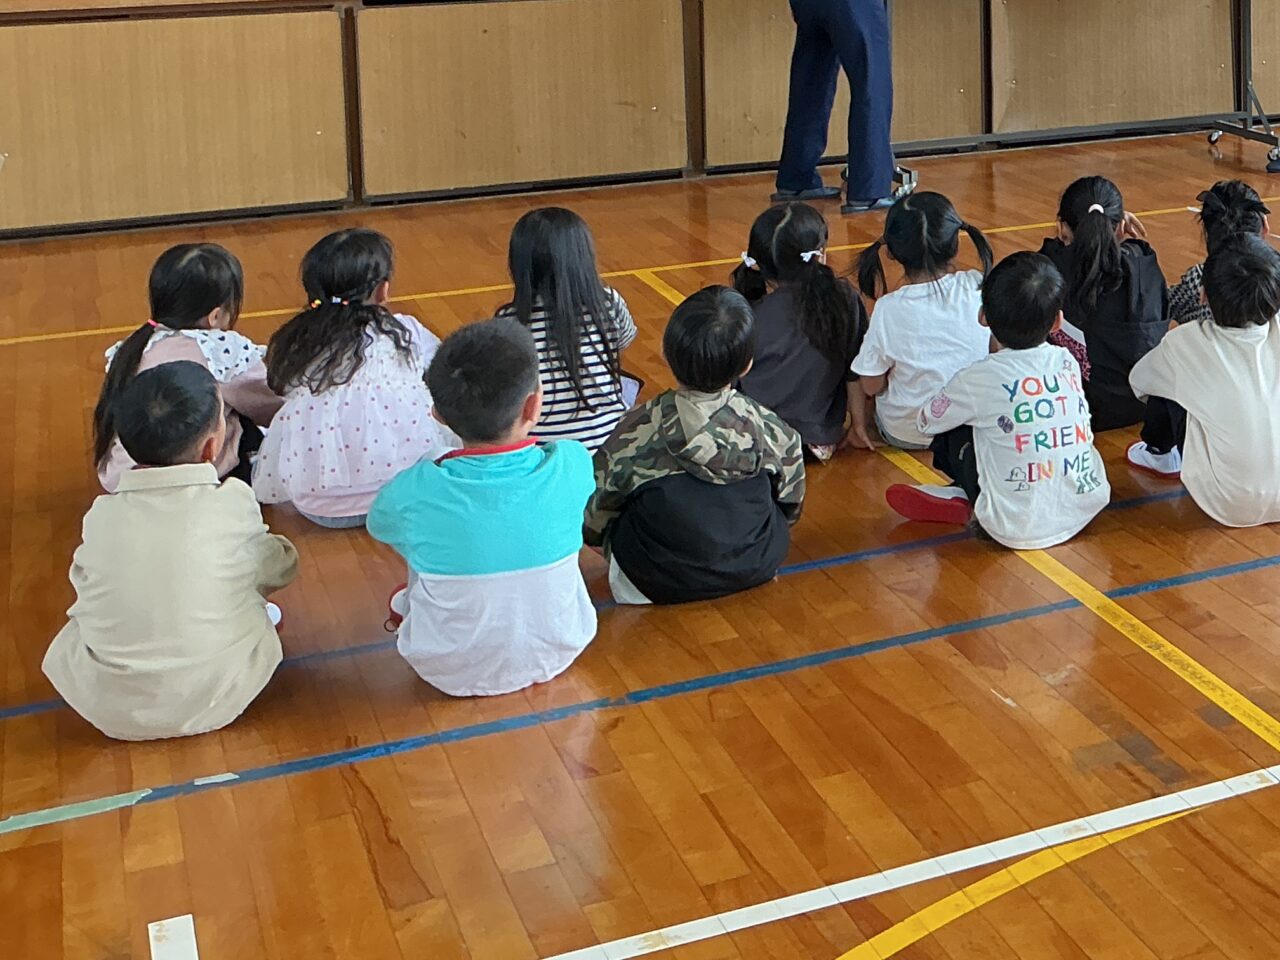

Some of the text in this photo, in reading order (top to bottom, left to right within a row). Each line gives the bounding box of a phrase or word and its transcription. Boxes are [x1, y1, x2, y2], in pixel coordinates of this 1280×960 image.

[1014, 396, 1068, 424] GOT
[1028, 450, 1090, 482] IN ME
